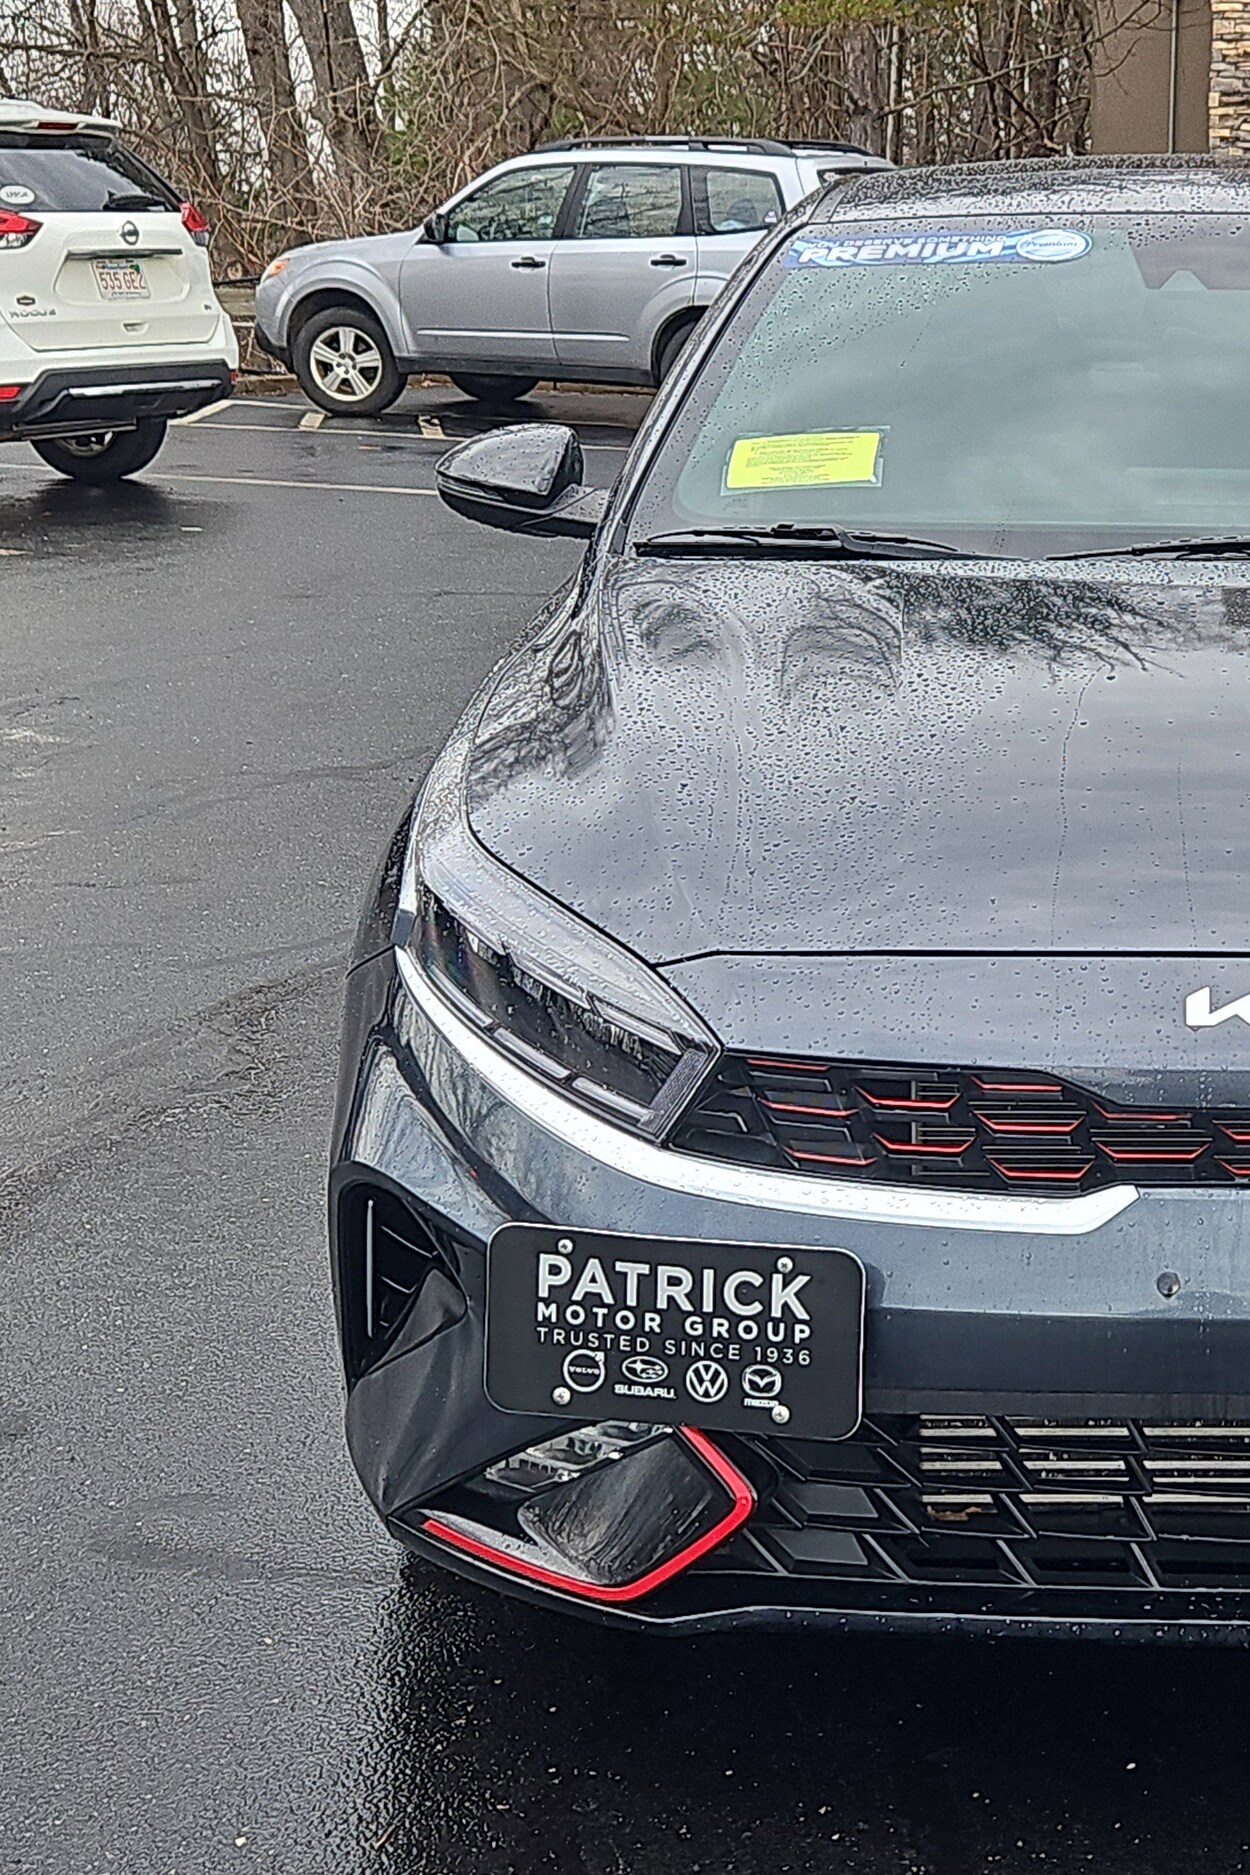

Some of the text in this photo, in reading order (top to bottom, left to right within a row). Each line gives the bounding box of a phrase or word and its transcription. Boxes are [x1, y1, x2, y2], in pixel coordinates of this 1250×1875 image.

[798, 240, 1005, 263] PREMIUM
[537, 1253, 811, 1320] PATRICK
[536, 1302, 811, 1344] MOTOR GROUP
[536, 1327, 811, 1366] TRUSTED SINCE 1936
[568, 1365, 601, 1375] VOLVO
[614, 1384, 675, 1398] SUBARU
